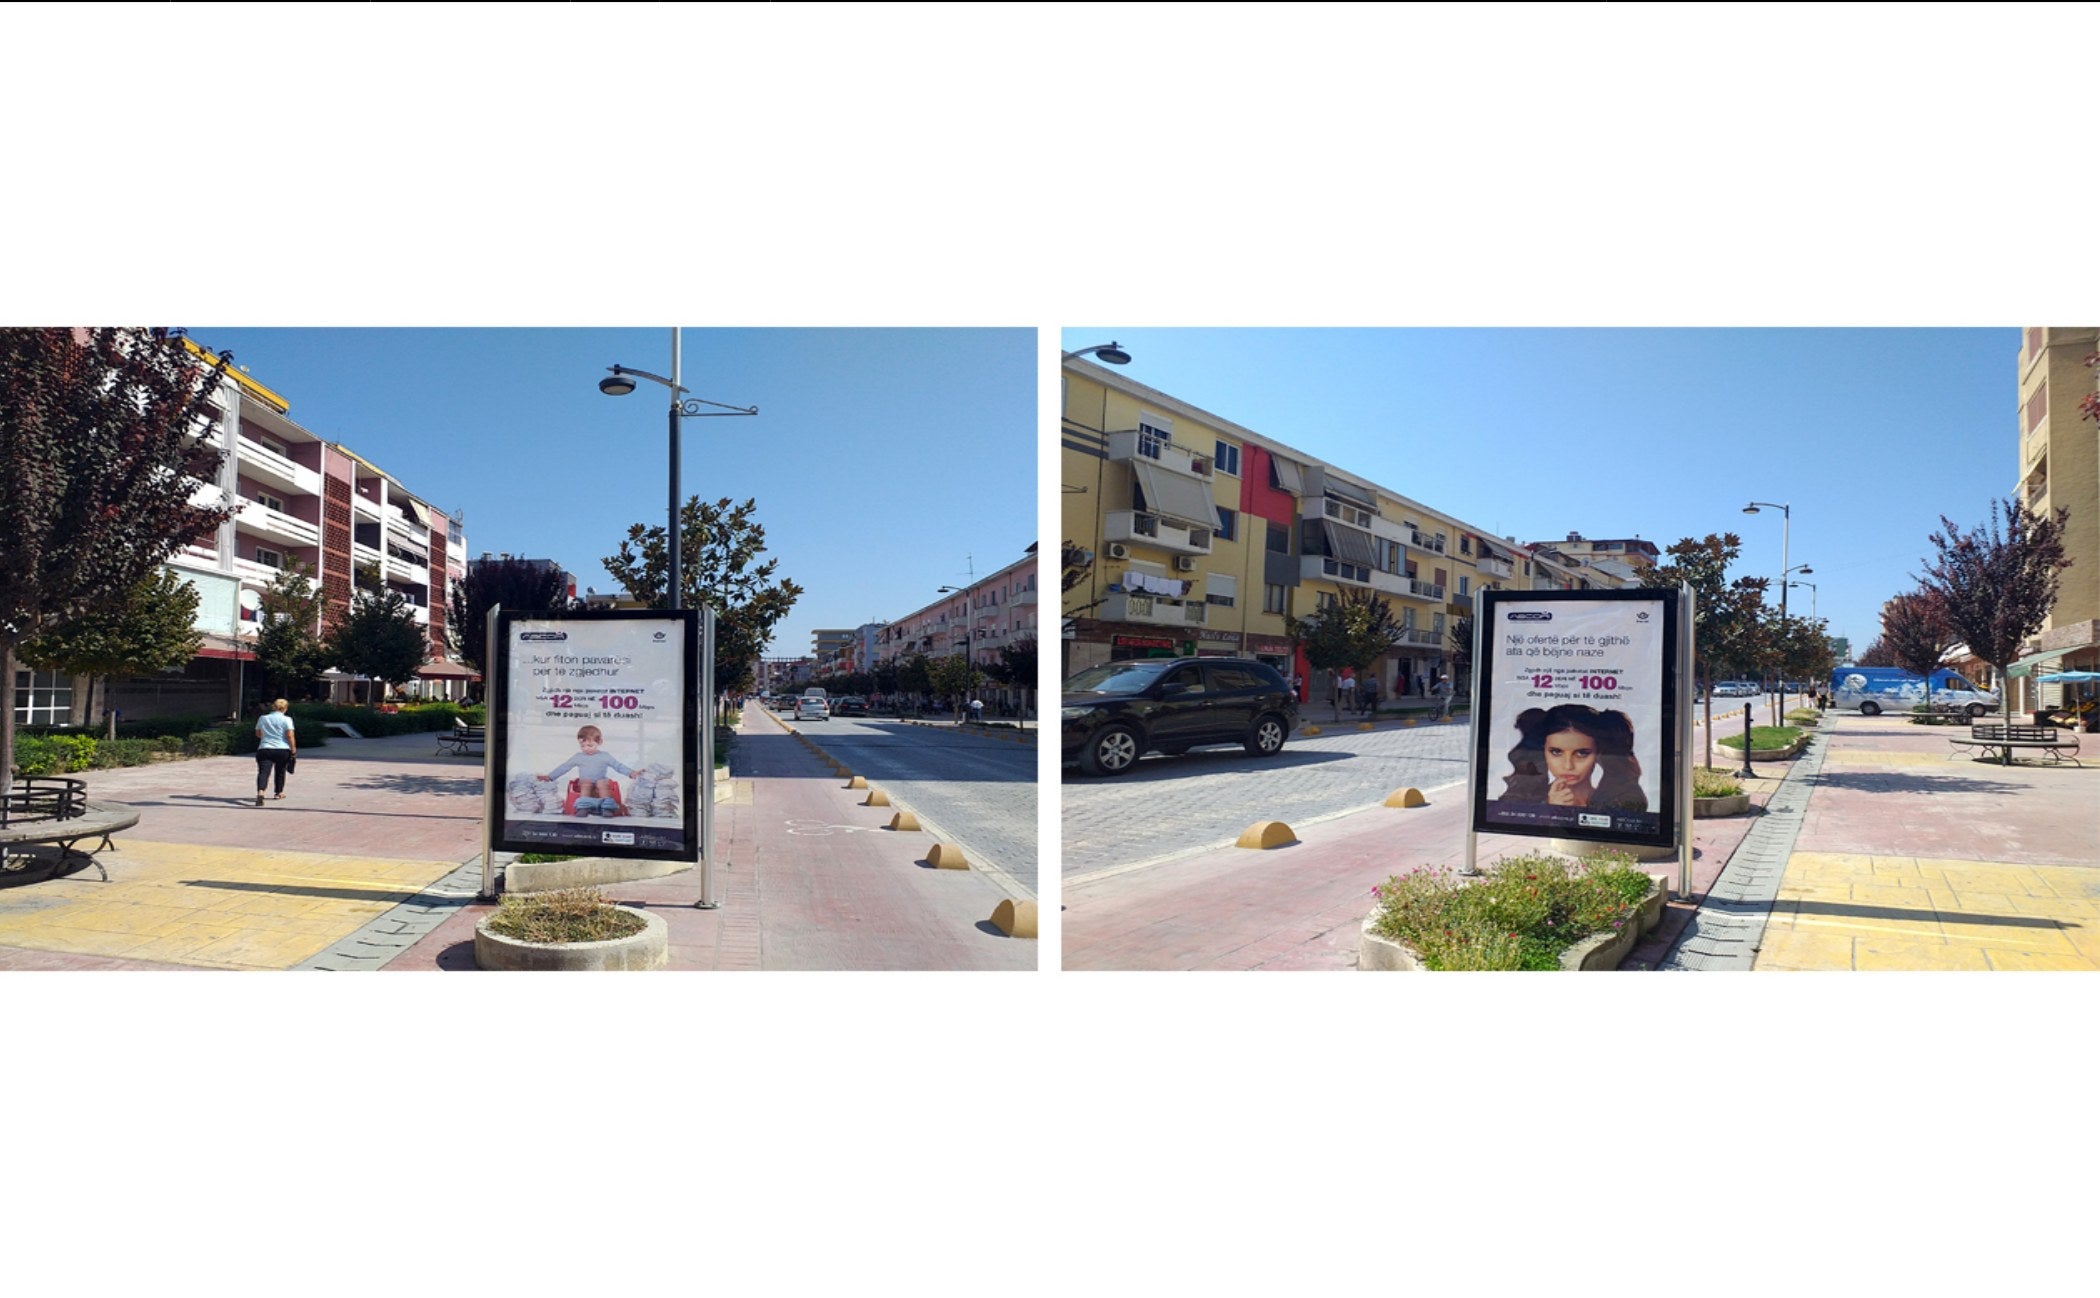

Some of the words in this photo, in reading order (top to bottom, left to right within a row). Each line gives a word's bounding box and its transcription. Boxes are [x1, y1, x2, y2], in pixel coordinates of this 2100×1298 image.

[1506, 634, 1524, 645] Një
[1527, 634, 1559, 645] ofertë
[1561, 635, 1580, 646] për
[1584, 635, 1595, 645] të
[1598, 635, 1631, 647] gjithë
[1506, 647, 1523, 656] ata
[1576, 648, 1604, 657] naze
[554, 655, 578, 664] fiton
[1531, 674, 1553, 688] 12
[1579, 675, 1617, 690] 100
[549, 694, 573, 708] 12
[599, 695, 638, 709] 100
